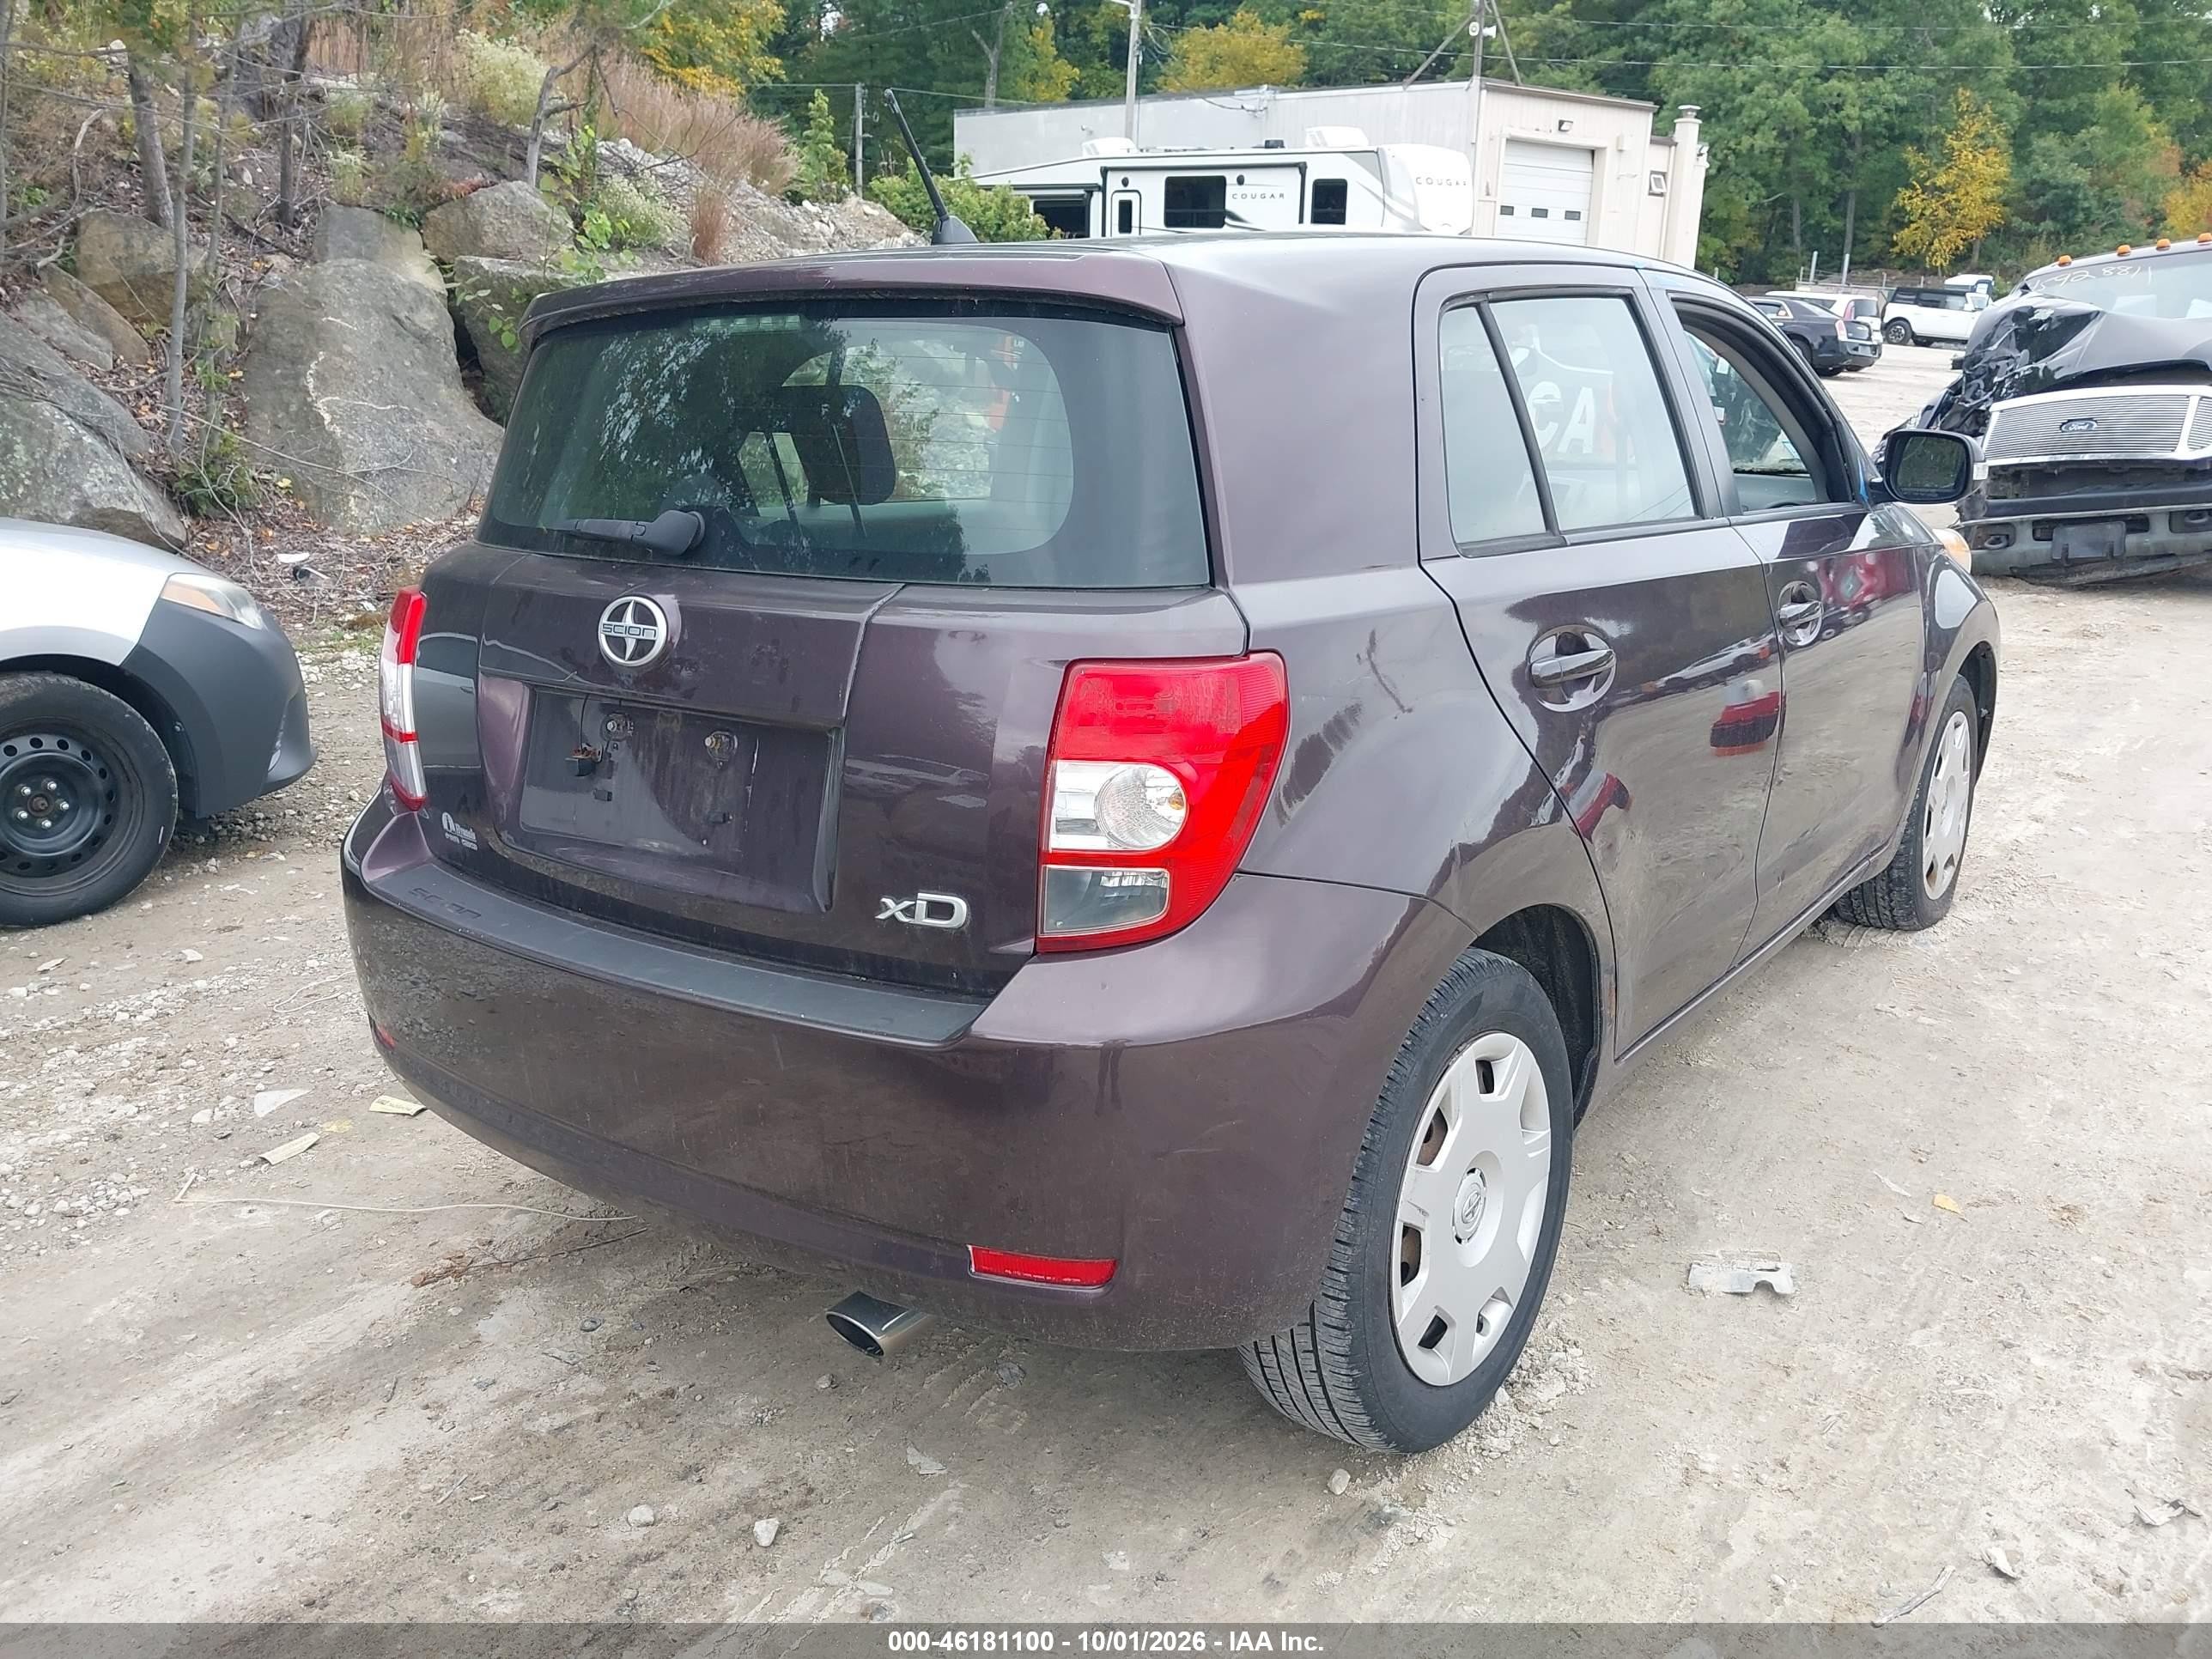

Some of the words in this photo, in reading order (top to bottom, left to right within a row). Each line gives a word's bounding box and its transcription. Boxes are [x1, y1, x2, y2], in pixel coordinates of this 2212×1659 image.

[602, 623, 657, 639] SCION
[408, 886, 483, 921] SCON
[874, 892, 968, 929] xD
